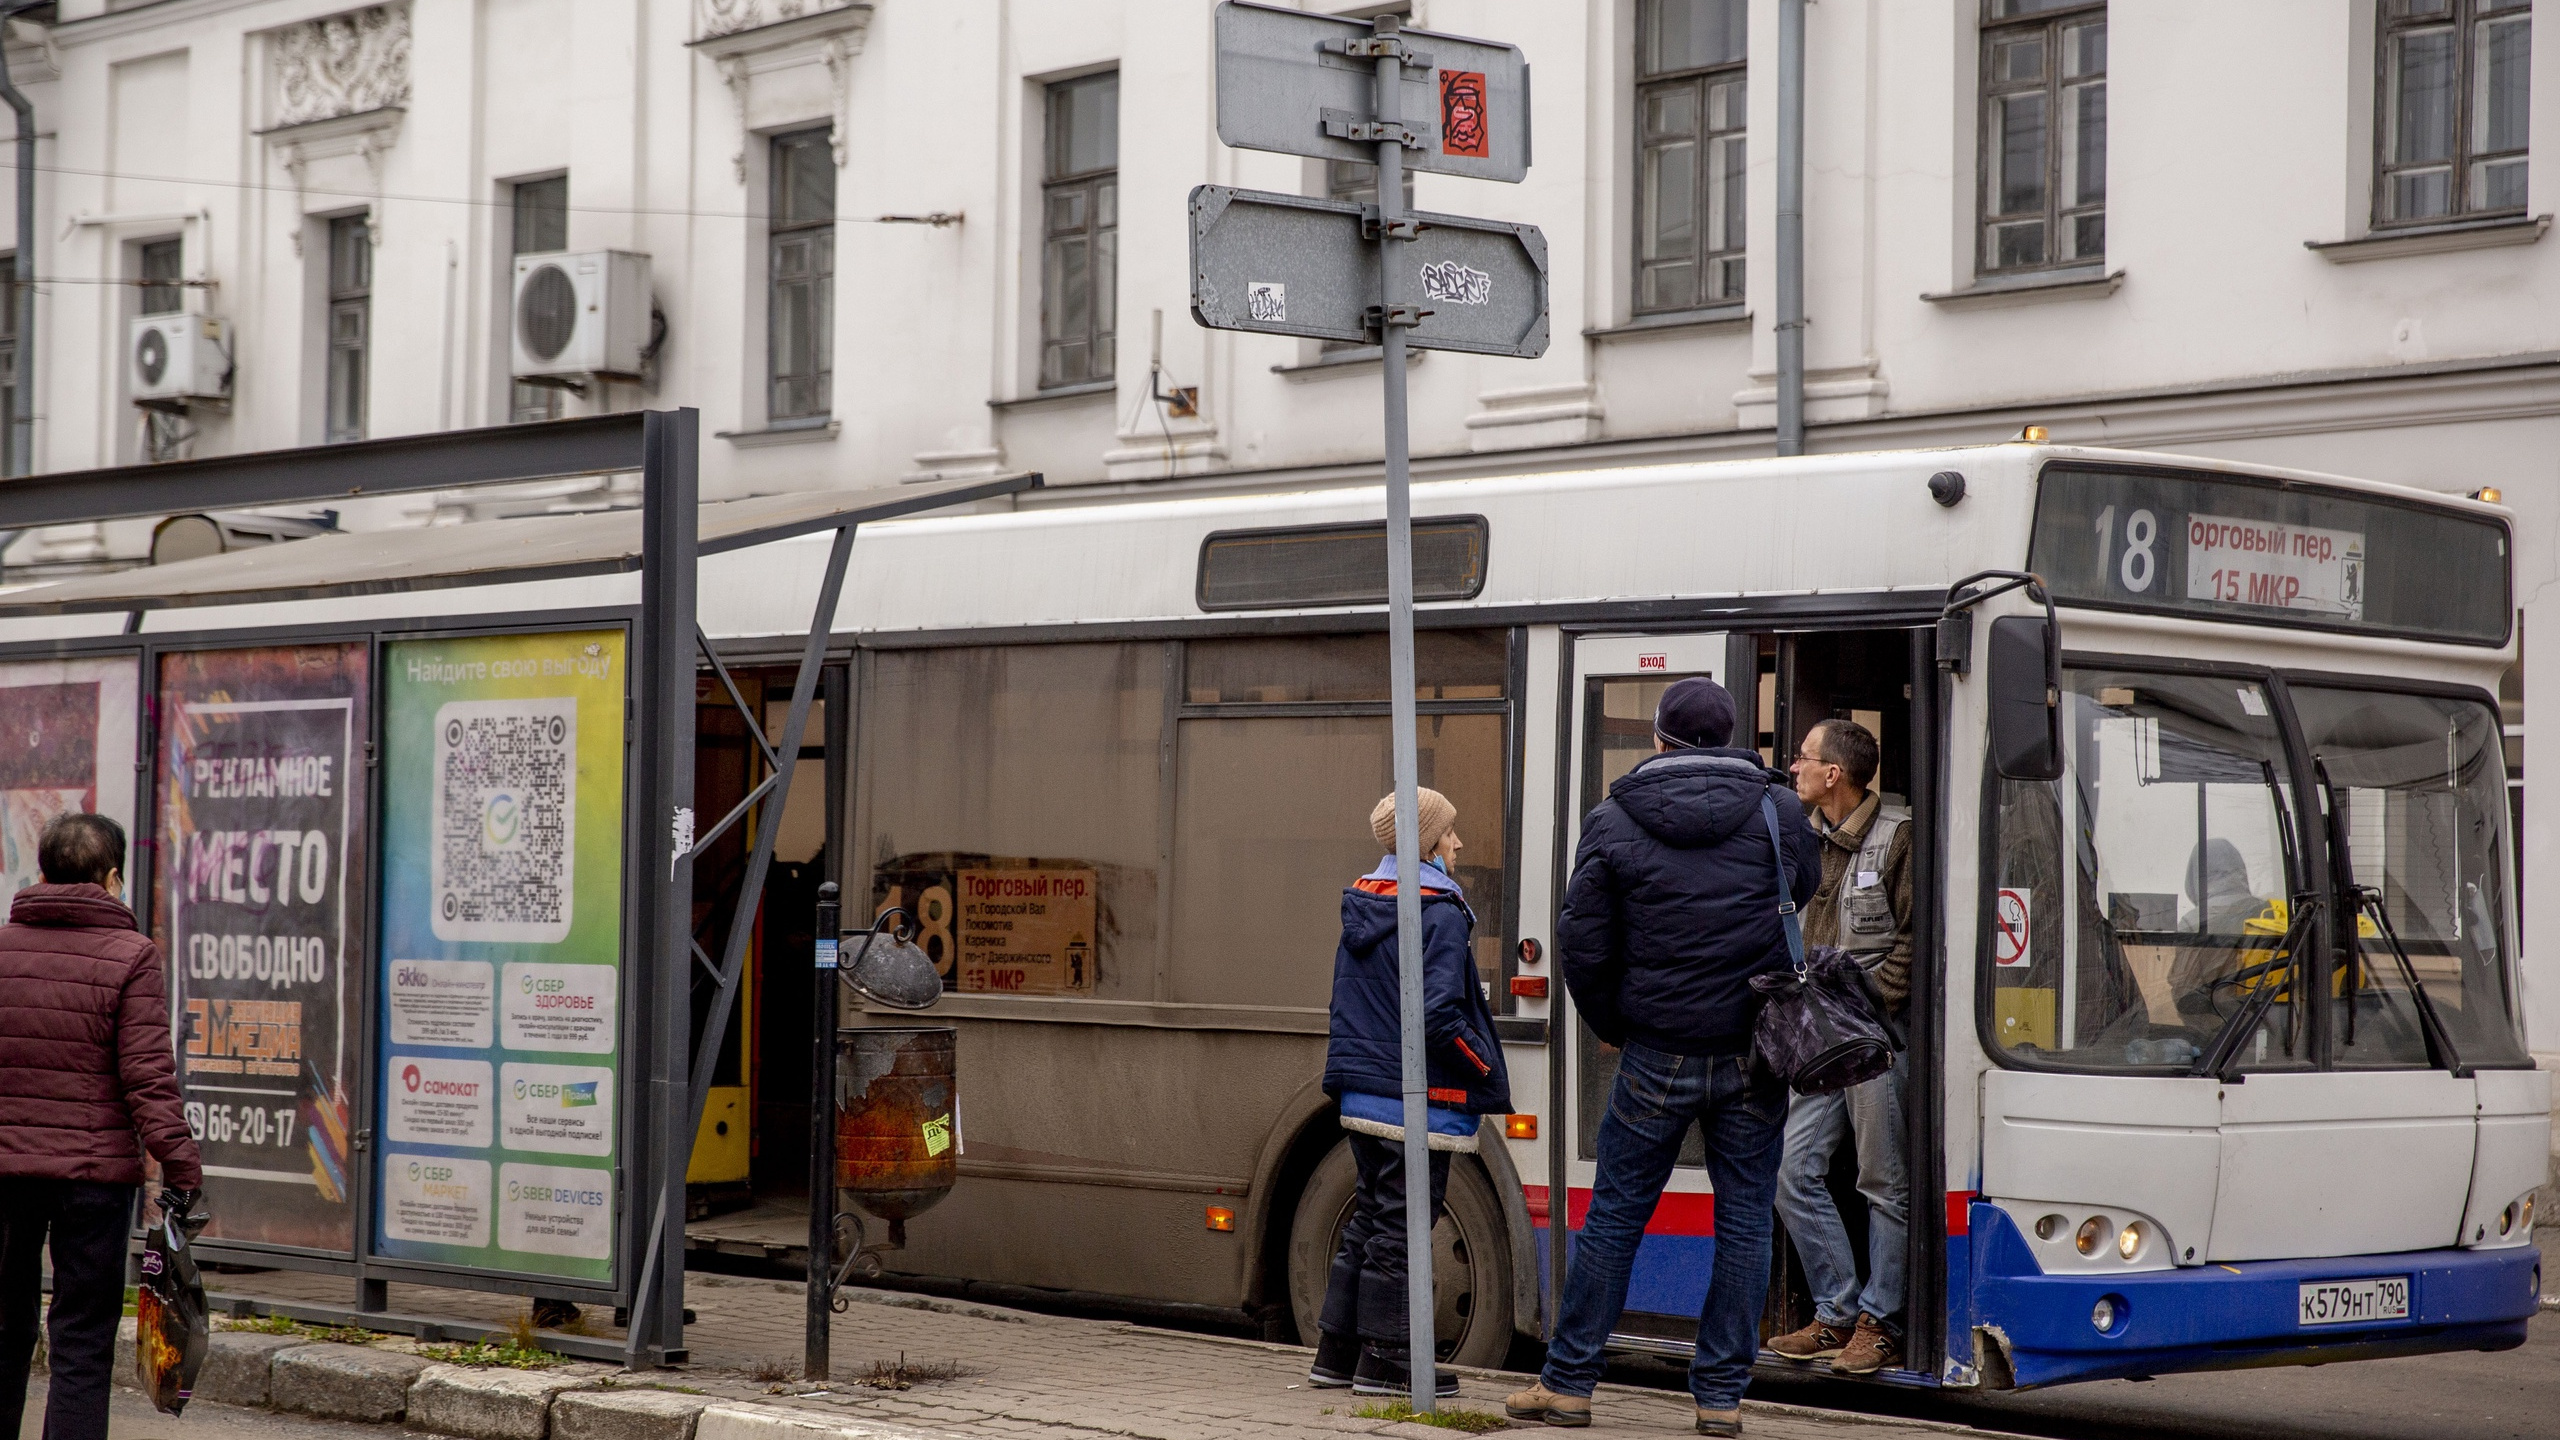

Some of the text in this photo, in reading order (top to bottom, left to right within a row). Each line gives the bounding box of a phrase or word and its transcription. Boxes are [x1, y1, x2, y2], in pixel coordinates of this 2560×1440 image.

[2188, 516, 2337, 564] орговый пер.
[2095, 505, 2157, 592] 18
[2211, 569, 2299, 606] 15 МКР
[407, 654, 611, 686] Найдите свою выгоду
[1641, 656, 1665, 669] ВХОД
[194, 756, 332, 797] РЕКЛАМНОЕ
[189, 830, 328, 906] МЕСТО
[966, 875, 1089, 900] Торговый пер.
[965, 902, 1045, 915] ул. Городской Вал
[965, 919, 1013, 931] Локомотив
[965, 937, 1007, 948] Карачиха
[190, 934, 325, 989] СВОБОДНО
[988, 953, 1052, 965] Дзержинского
[536, 979, 564, 992] СБЕР
[966, 970, 1025, 990] 15 МКР
[535, 995, 594, 1010] ЗДОРОВЬЕ
[227, 1022, 301, 1062] МЕДИА
[424, 1081, 479, 1097] самокат
[530, 1084, 559, 1098] СБЕР
[564, 1089, 591, 1101] Прайм
[207, 1105, 296, 1147] 66-20-17
[526, 1115, 537, 1123] Все
[558, 1118, 585, 1127] сервисы
[515, 1127, 534, 1136] одной
[536, 1129, 565, 1138] выгодной
[568, 1131, 602, 1141] подписке!
[424, 1167, 453, 1181] СБЕР
[422, 1183, 468, 1200] МАРКЕТ
[523, 1186, 603, 1206] SBER DEVICES
[524, 1211, 584, 1225] Умные устройства
[526, 1225, 579, 1237] для всей семьи!
[2378, 1282, 2404, 1307] 790
[2383, 1305, 2397, 1314] RUS
